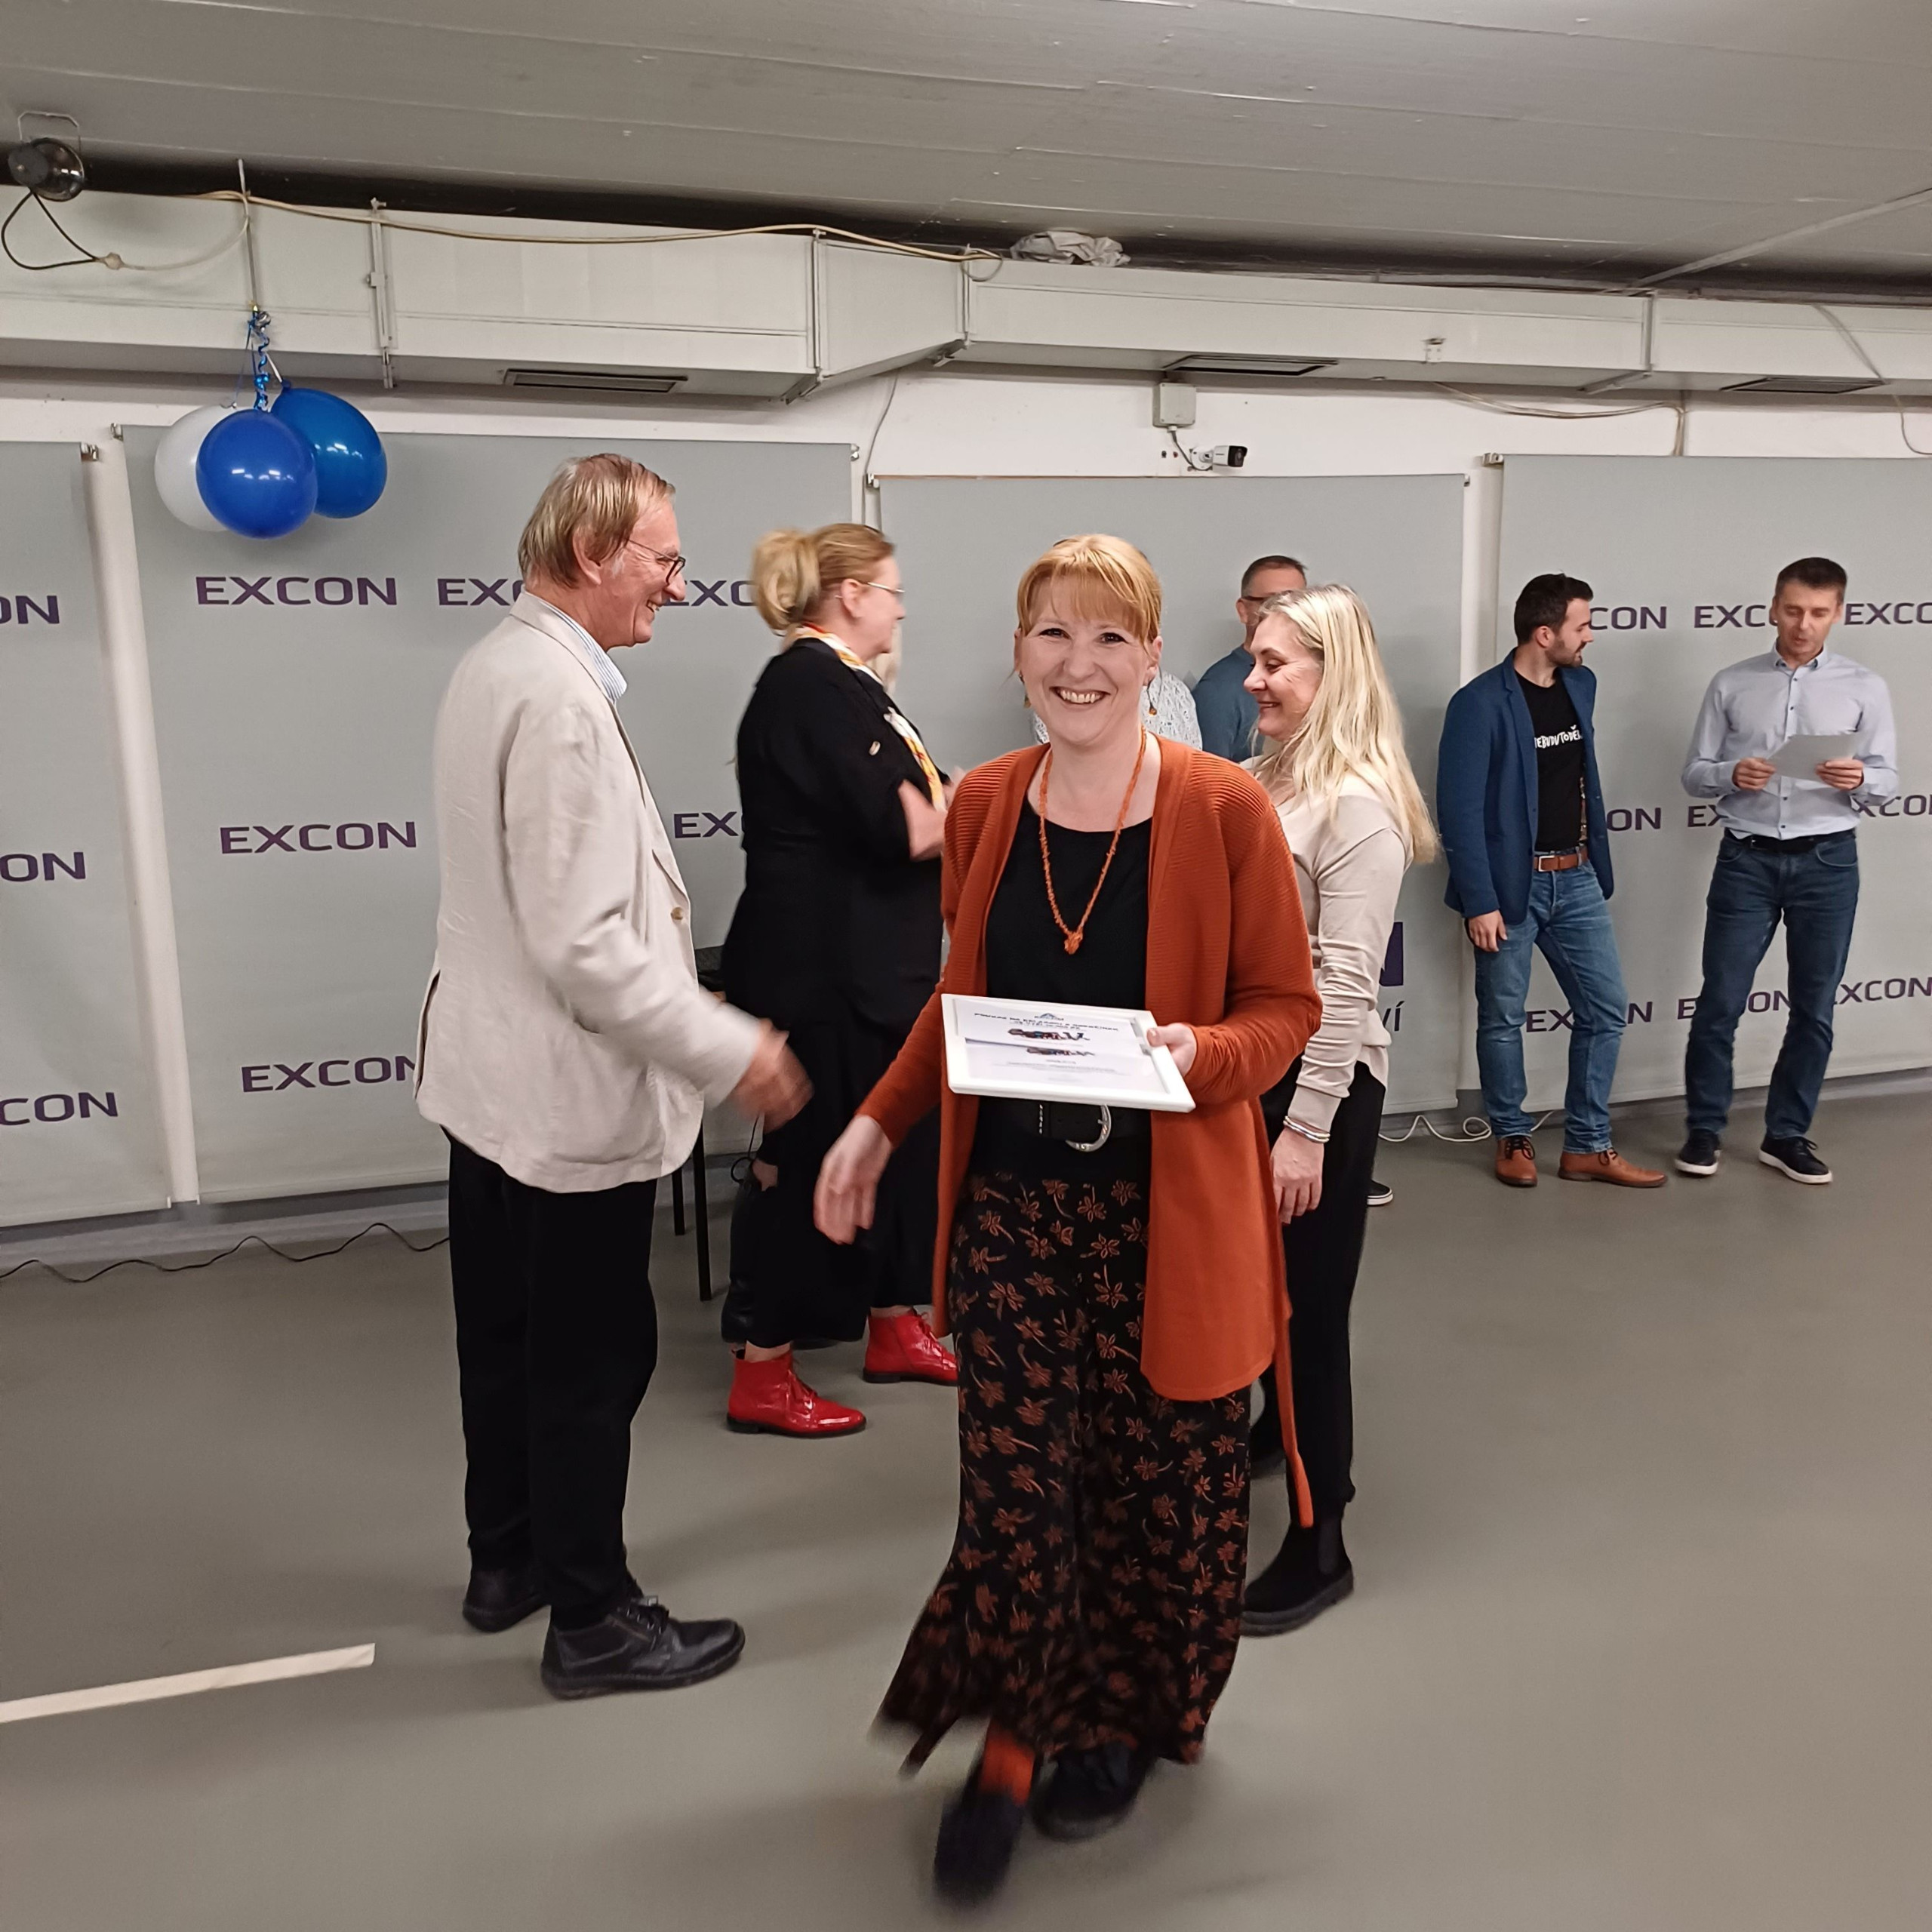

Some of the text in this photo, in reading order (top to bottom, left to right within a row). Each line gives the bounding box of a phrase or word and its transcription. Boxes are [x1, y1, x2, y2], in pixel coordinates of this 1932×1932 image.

[196, 576, 398, 605] EXCON
[0, 595, 60, 625] N
[1694, 605, 1778, 629] EXC
[673, 811, 740, 838] EX
[1606, 807, 1662, 832] ON
[220, 821, 417, 854] EXCON
[1833, 977, 1932, 1005] XCON
[0, 1091, 118, 1126] CON
